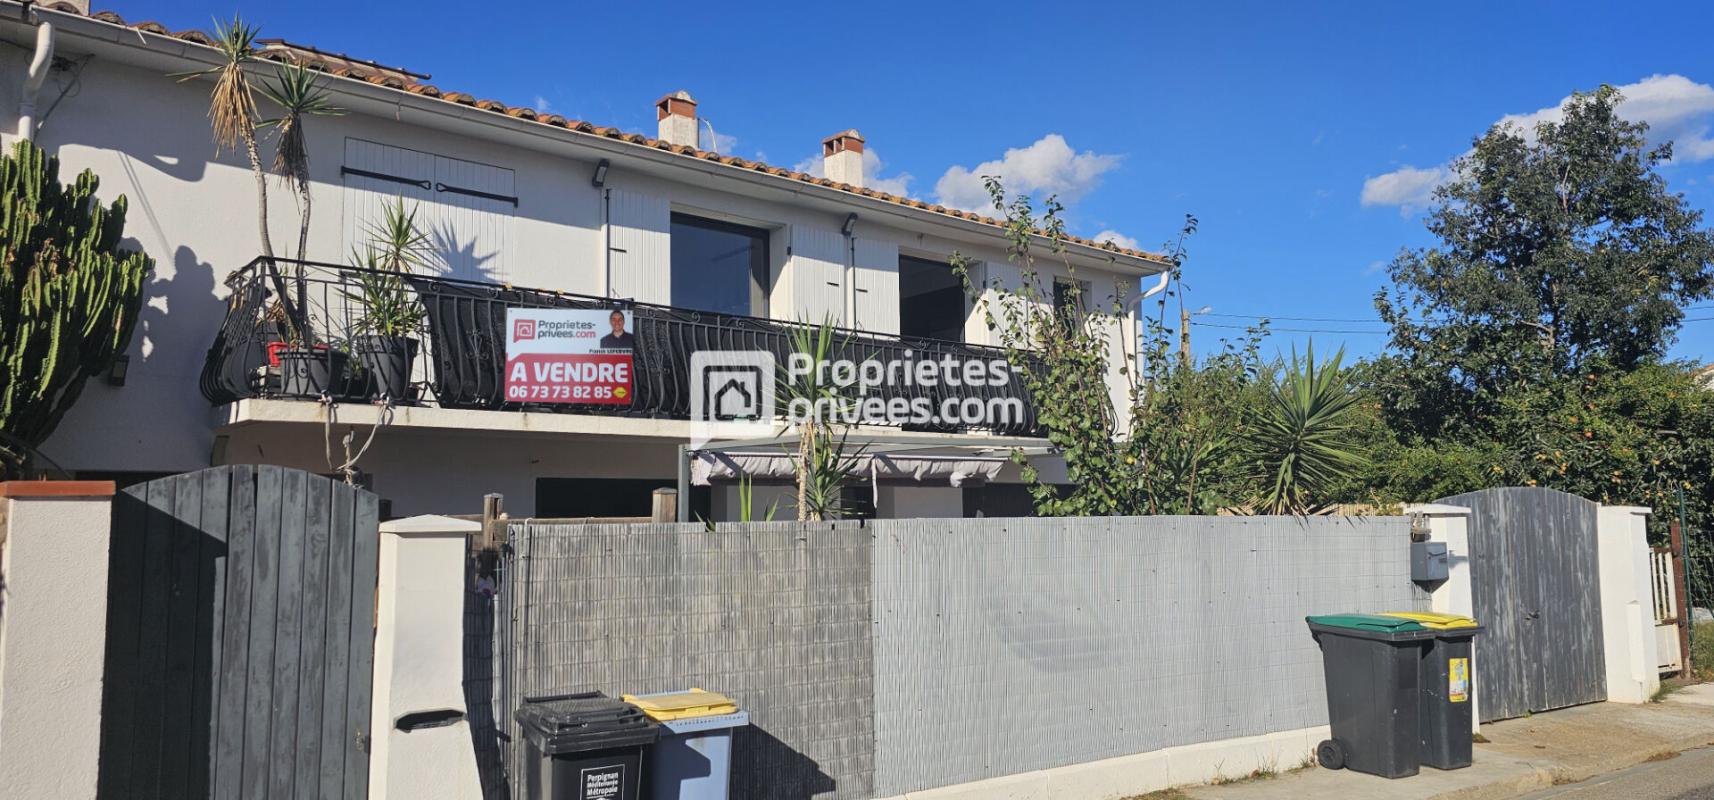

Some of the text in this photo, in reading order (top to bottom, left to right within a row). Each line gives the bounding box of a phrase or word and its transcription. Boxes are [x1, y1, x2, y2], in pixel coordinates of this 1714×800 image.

[538, 320, 596, 330] Proprietes-
[538, 329, 596, 339] privees.com
[510, 362, 628, 383] A VENDRE
[509, 385, 612, 399] 06 73 73 82 85
